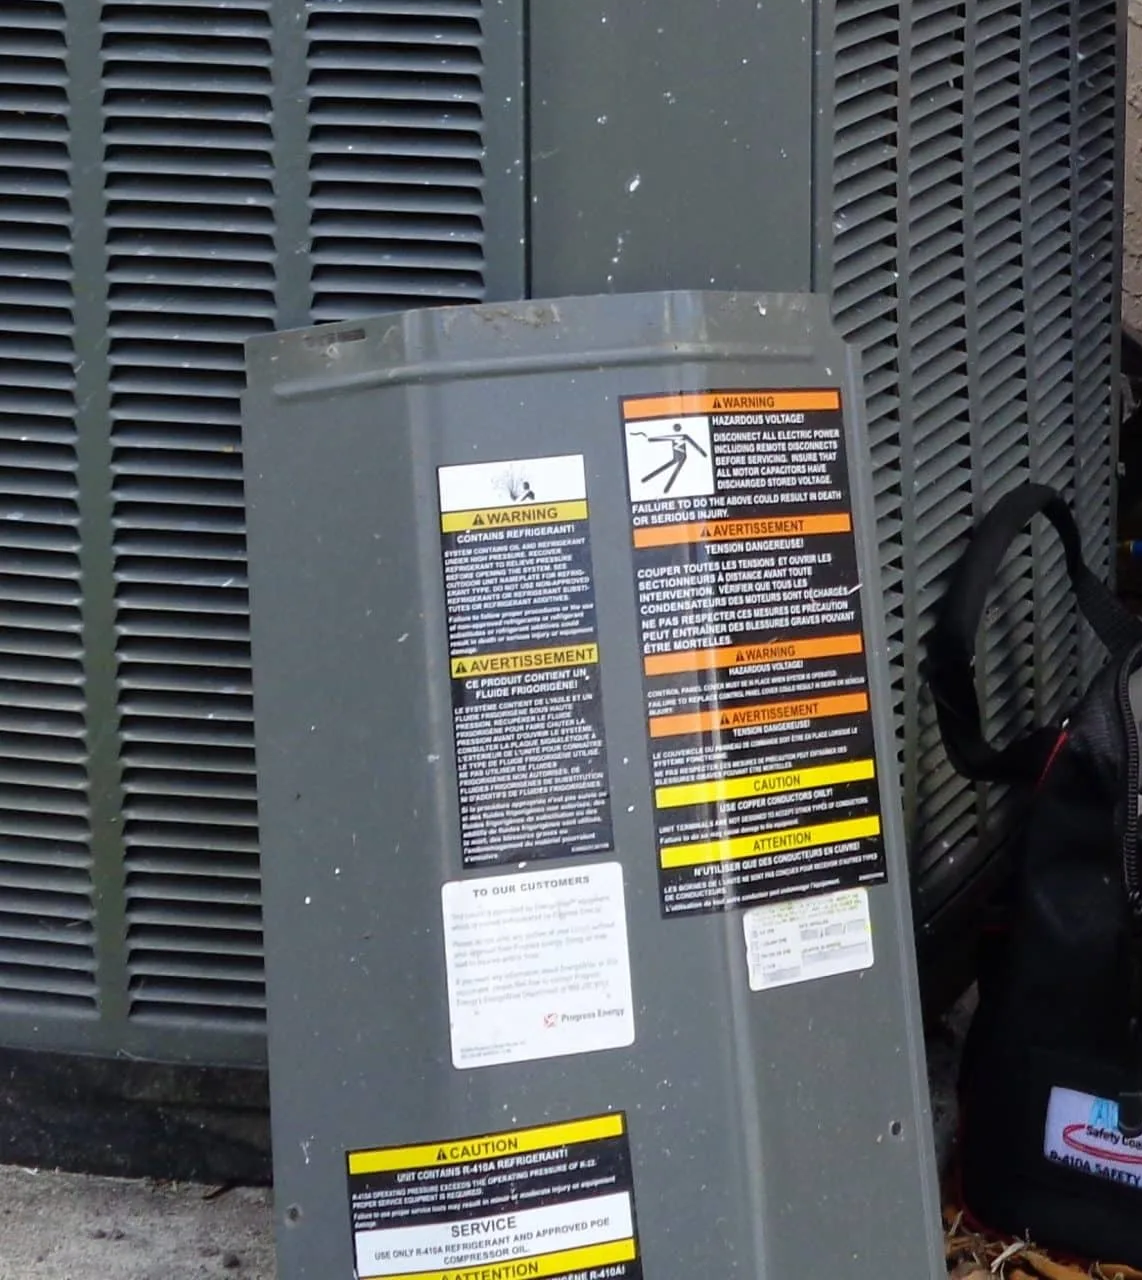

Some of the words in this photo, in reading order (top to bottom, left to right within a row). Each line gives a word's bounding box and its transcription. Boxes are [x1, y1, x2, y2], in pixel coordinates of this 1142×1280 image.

[724, 396, 774, 408] WARNING
[713, 415, 762, 425] HAZARDOUS
[766, 413, 804, 423] VOLTAGE!
[714, 432, 761, 442] DISCONNECT
[762, 431, 775, 441] ALL
[778, 430, 812, 440] ELECTRIC
[814, 429, 839, 439] POWER
[715, 444, 754, 454] INCLUDING
[757, 443, 785, 452] REMOTE
[788, 441, 837, 451] DISCONNECTS
[716, 456, 745, 465] BEFORE
[748, 454, 788, 464] SERVICING.
[792, 453, 817, 463] INSURE
[819, 452, 836, 462] THAT
[717, 468, 732, 477] ALL
[733, 467, 759, 477] MOTOR
[761, 465, 806, 475] CAPACITORS
[808, 464, 826, 473] HAVE
[718, 478, 765, 489] DISCHARGED
[768, 477, 795, 487] STORED
[632, 502, 675, 513] FAILURE
[679, 501, 690, 510] TO
[694, 499, 707, 509] DO
[710, 498, 725, 508] THE
[727, 496, 752, 507] ABOVE
[754, 495, 778, 505] COULD
[781, 493, 808, 503] RESULT
[809, 492, 816, 501] IN
[818, 491, 841, 501] DEATH
[487, 508, 557, 524] WARNING
[633, 515, 648, 525] OR
[651, 511, 695, 524] SERIOUS
[714, 521, 803, 536] AVERTISSEMENT
[457, 531, 504, 543] CONTAINS
[705, 542, 743, 554] TENSION
[746, 538, 803, 551] DANGEREUSE!
[470, 648, 594, 672] AVERTISSEMENT
[746, 646, 795, 661] WARNING
[466, 679, 478, 689] CE
[481, 675, 522, 687] PRODUIT
[525, 670, 570, 683] CONTIENT
[573, 668, 586, 678] UN
[476, 687, 509, 700] FLUIDE
[733, 703, 818, 724] AVERTISSEMENT
[754, 775, 800, 791] CAUTION
[753, 832, 811, 851] ATTENTION
[473, 888, 487, 897] TO
[493, 884, 515, 895] OUR
[521, 876, 589, 892] CUSTOMERS
[1086, 1125, 1120, 1144] Safety
[450, 1138, 517, 1159] CAUTION
[397, 1171, 415, 1182] UNIT
[417, 1165, 460, 1179] CONTAINS
[463, 1160, 495, 1173] R-410A
[1094, 1163, 1140, 1187] SAFETY
[451, 1216, 516, 1238] SERVICE
[375, 1251, 391, 1260] USE
[393, 1248, 414, 1259] ONLY
[445, 1237, 510, 1253] REFRIGERANT
[513, 1232, 532, 1245] AND
[536, 1222, 587, 1241] APPROVED
[444, 1248, 509, 1265] COMPRESSOR
[455, 1262, 539, 1280] ATTENTION
